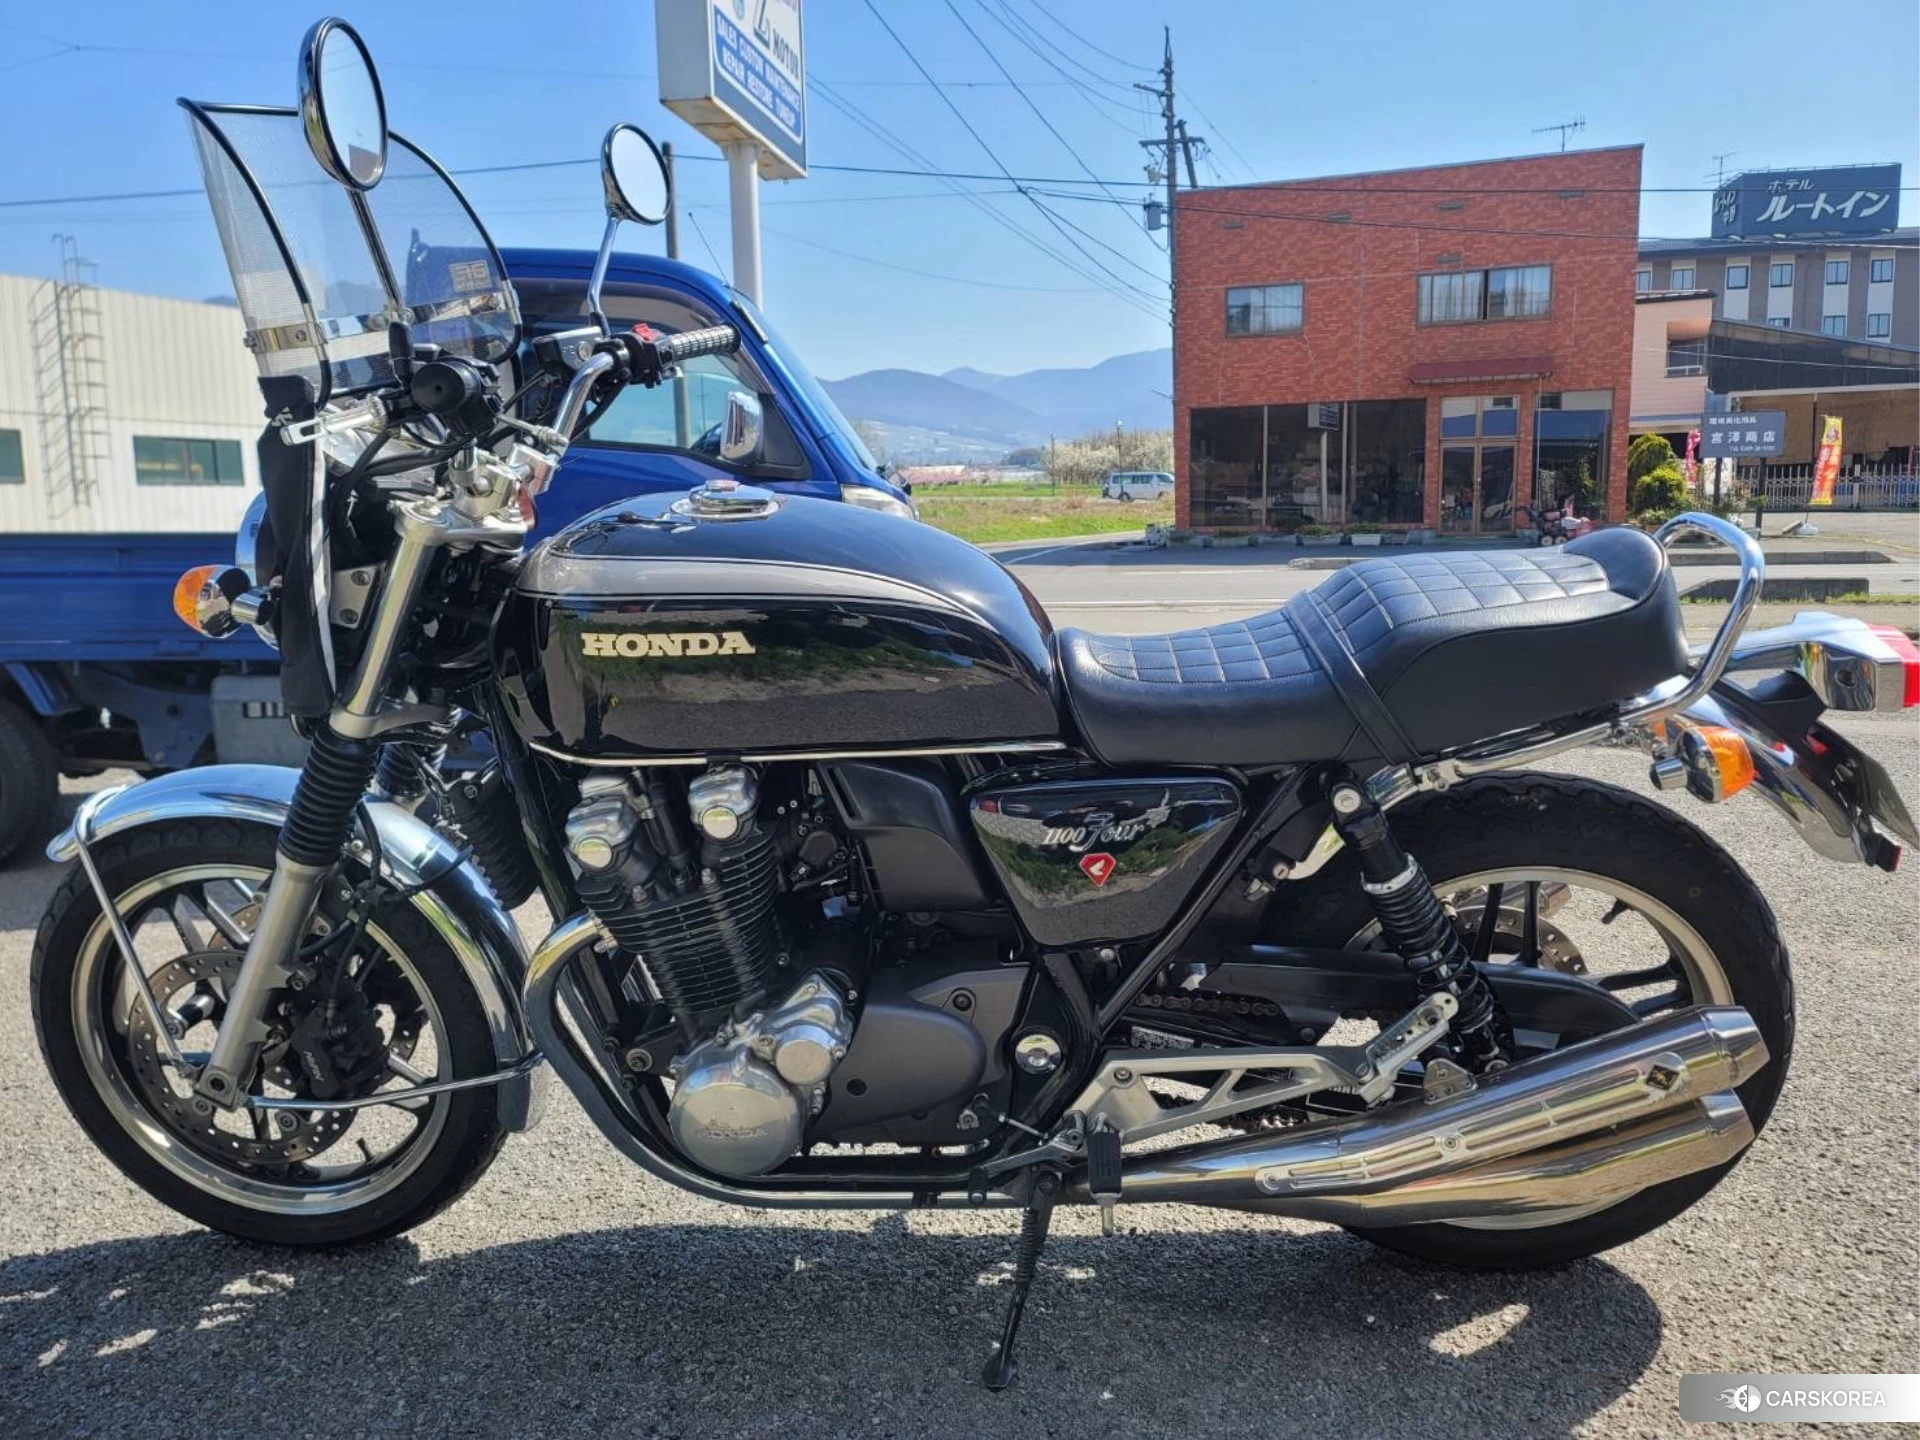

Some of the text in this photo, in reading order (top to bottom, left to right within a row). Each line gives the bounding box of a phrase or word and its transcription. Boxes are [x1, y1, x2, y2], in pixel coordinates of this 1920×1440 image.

[1768, 178, 1815, 193] ホテル
[1757, 190, 1890, 222] ルートイン
[581, 631, 756, 657] HONDA
[1041, 827, 1085, 845] 1100
